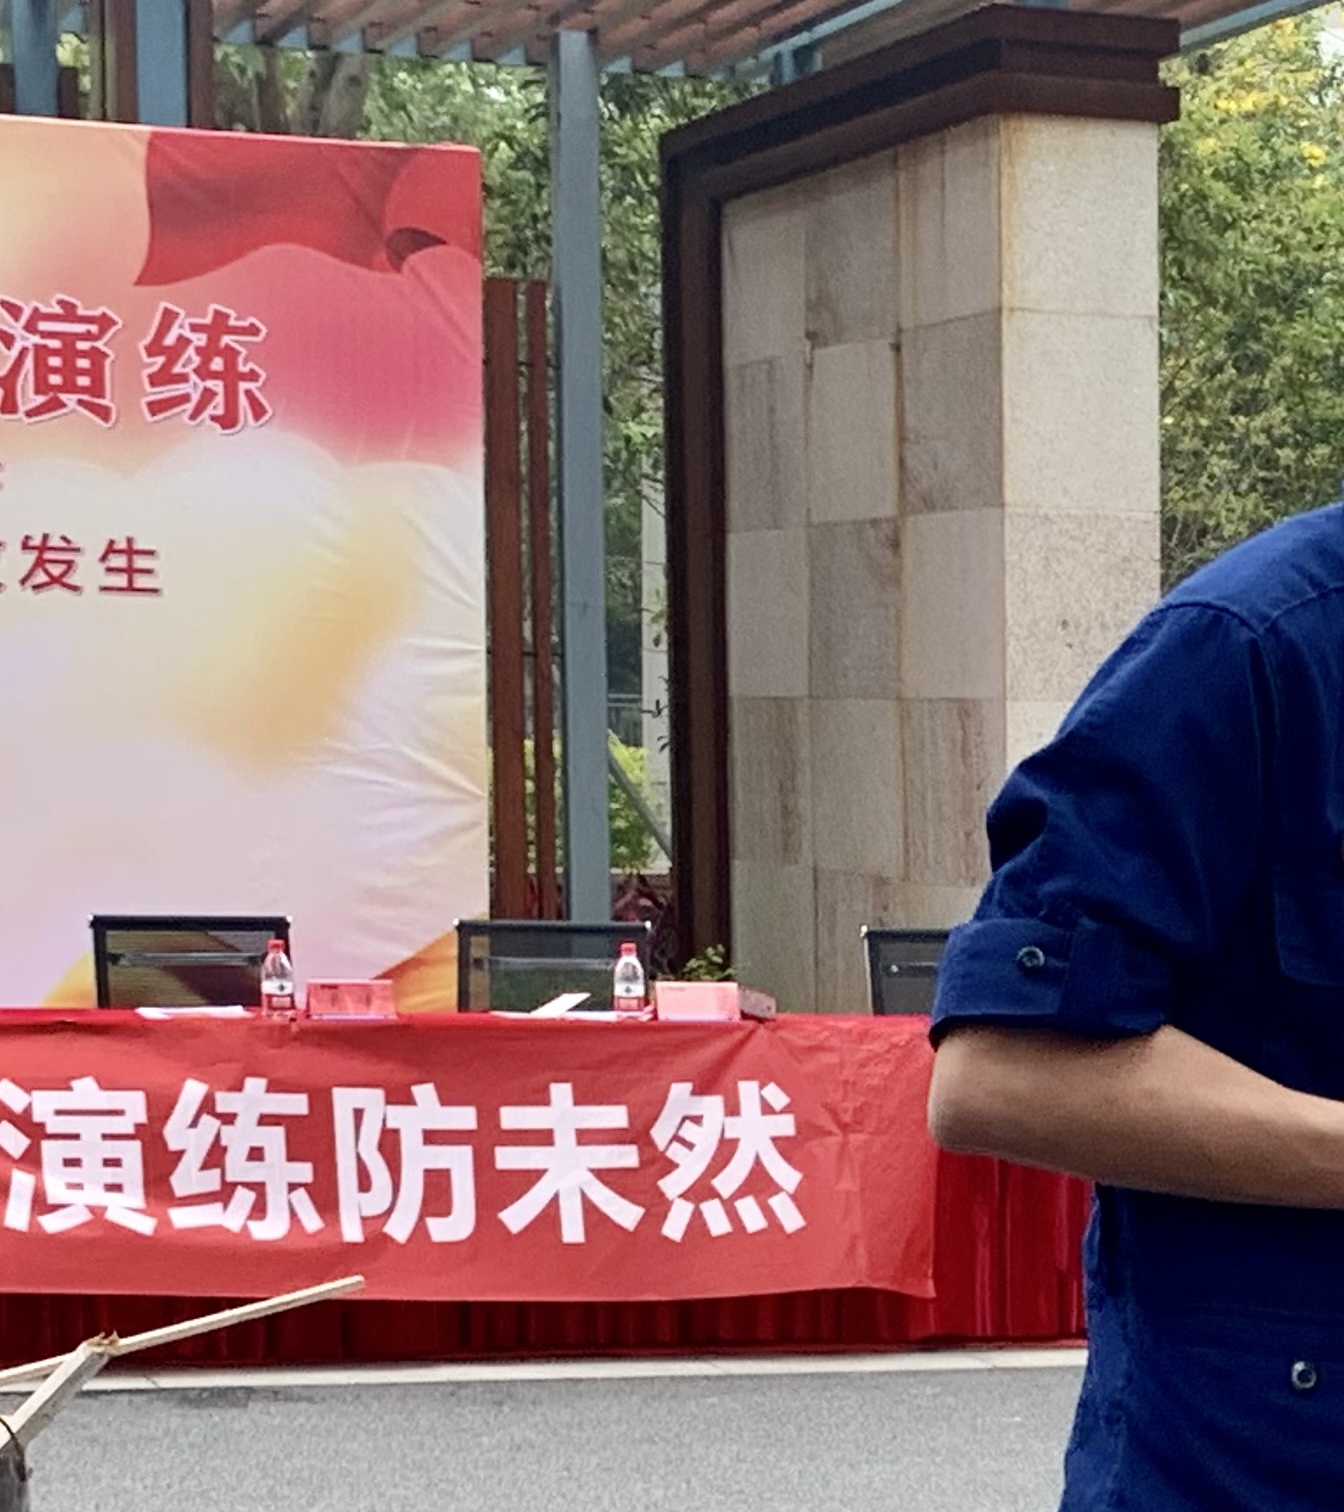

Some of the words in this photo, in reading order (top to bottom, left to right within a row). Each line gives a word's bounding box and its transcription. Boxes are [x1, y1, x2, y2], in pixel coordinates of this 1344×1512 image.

[0, 296, 271, 434] 演练
[0, 533, 161, 597] 发生
[0, 1076, 806, 1245] 演练防未然
